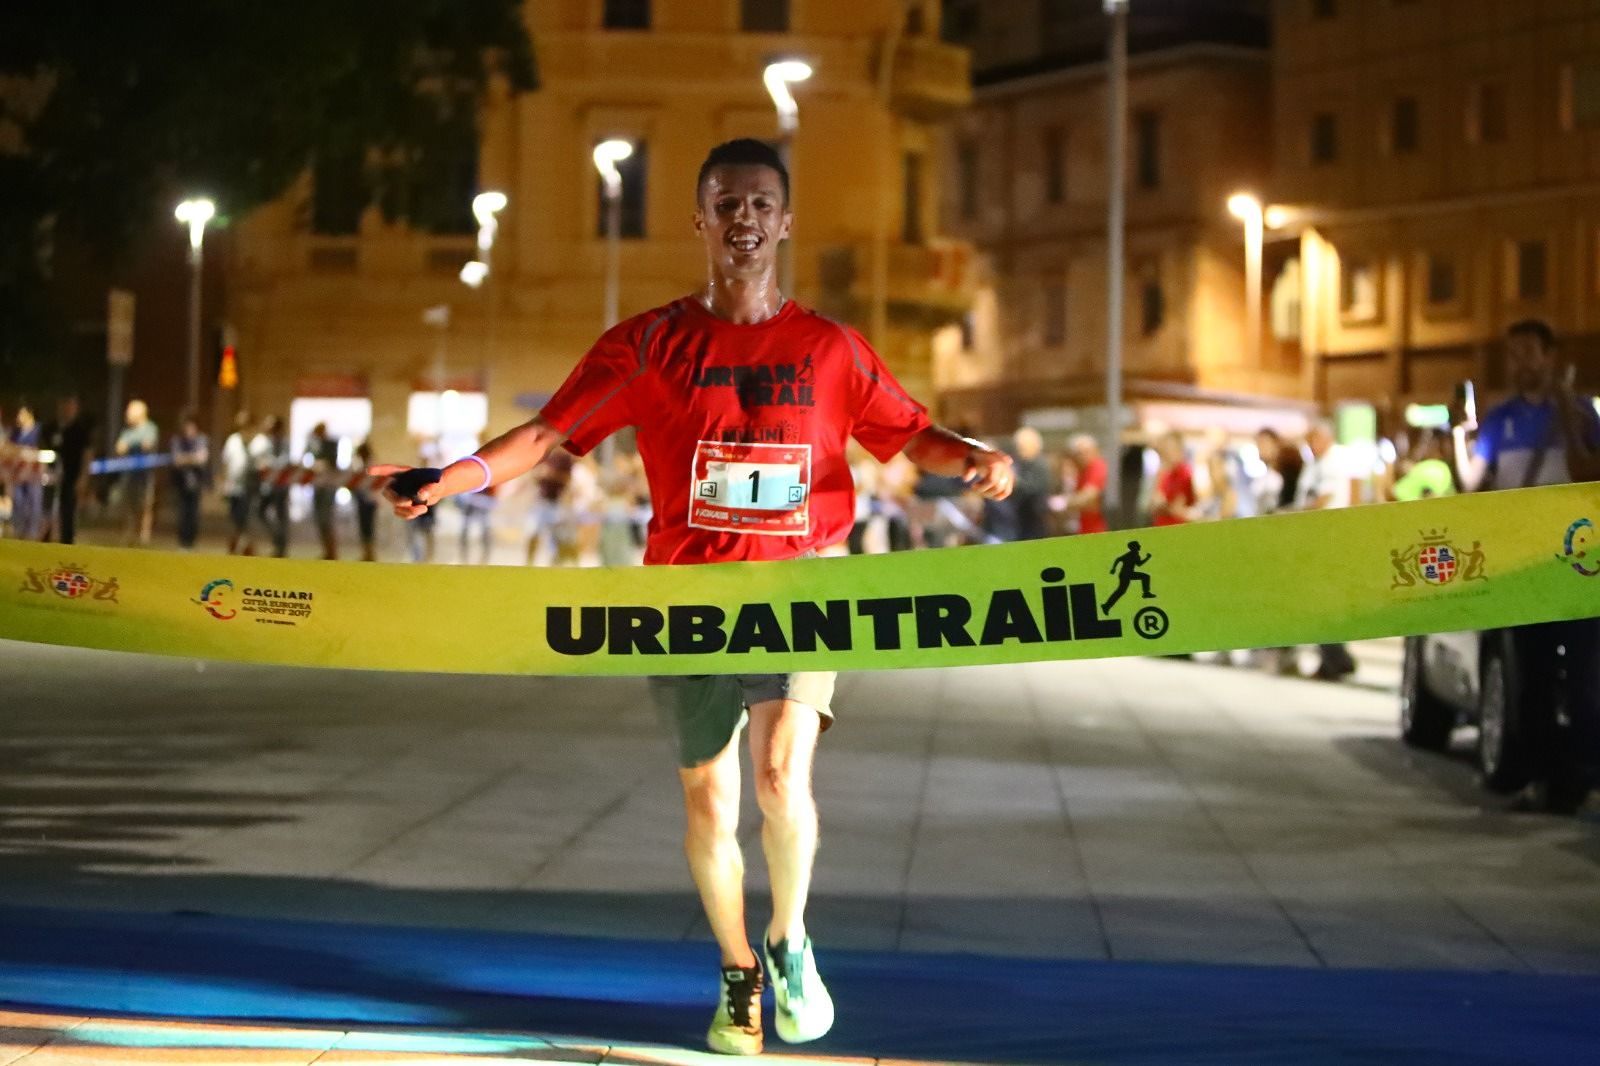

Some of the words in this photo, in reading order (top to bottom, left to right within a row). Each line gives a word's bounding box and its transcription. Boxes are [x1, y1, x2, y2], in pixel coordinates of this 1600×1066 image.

[693, 364, 796, 388] URBAN
[748, 470, 760, 503] 1
[242, 588, 313, 600] CAGLIARI
[269, 600, 312, 610] EUROPEA
[288, 609, 312, 618] 2017
